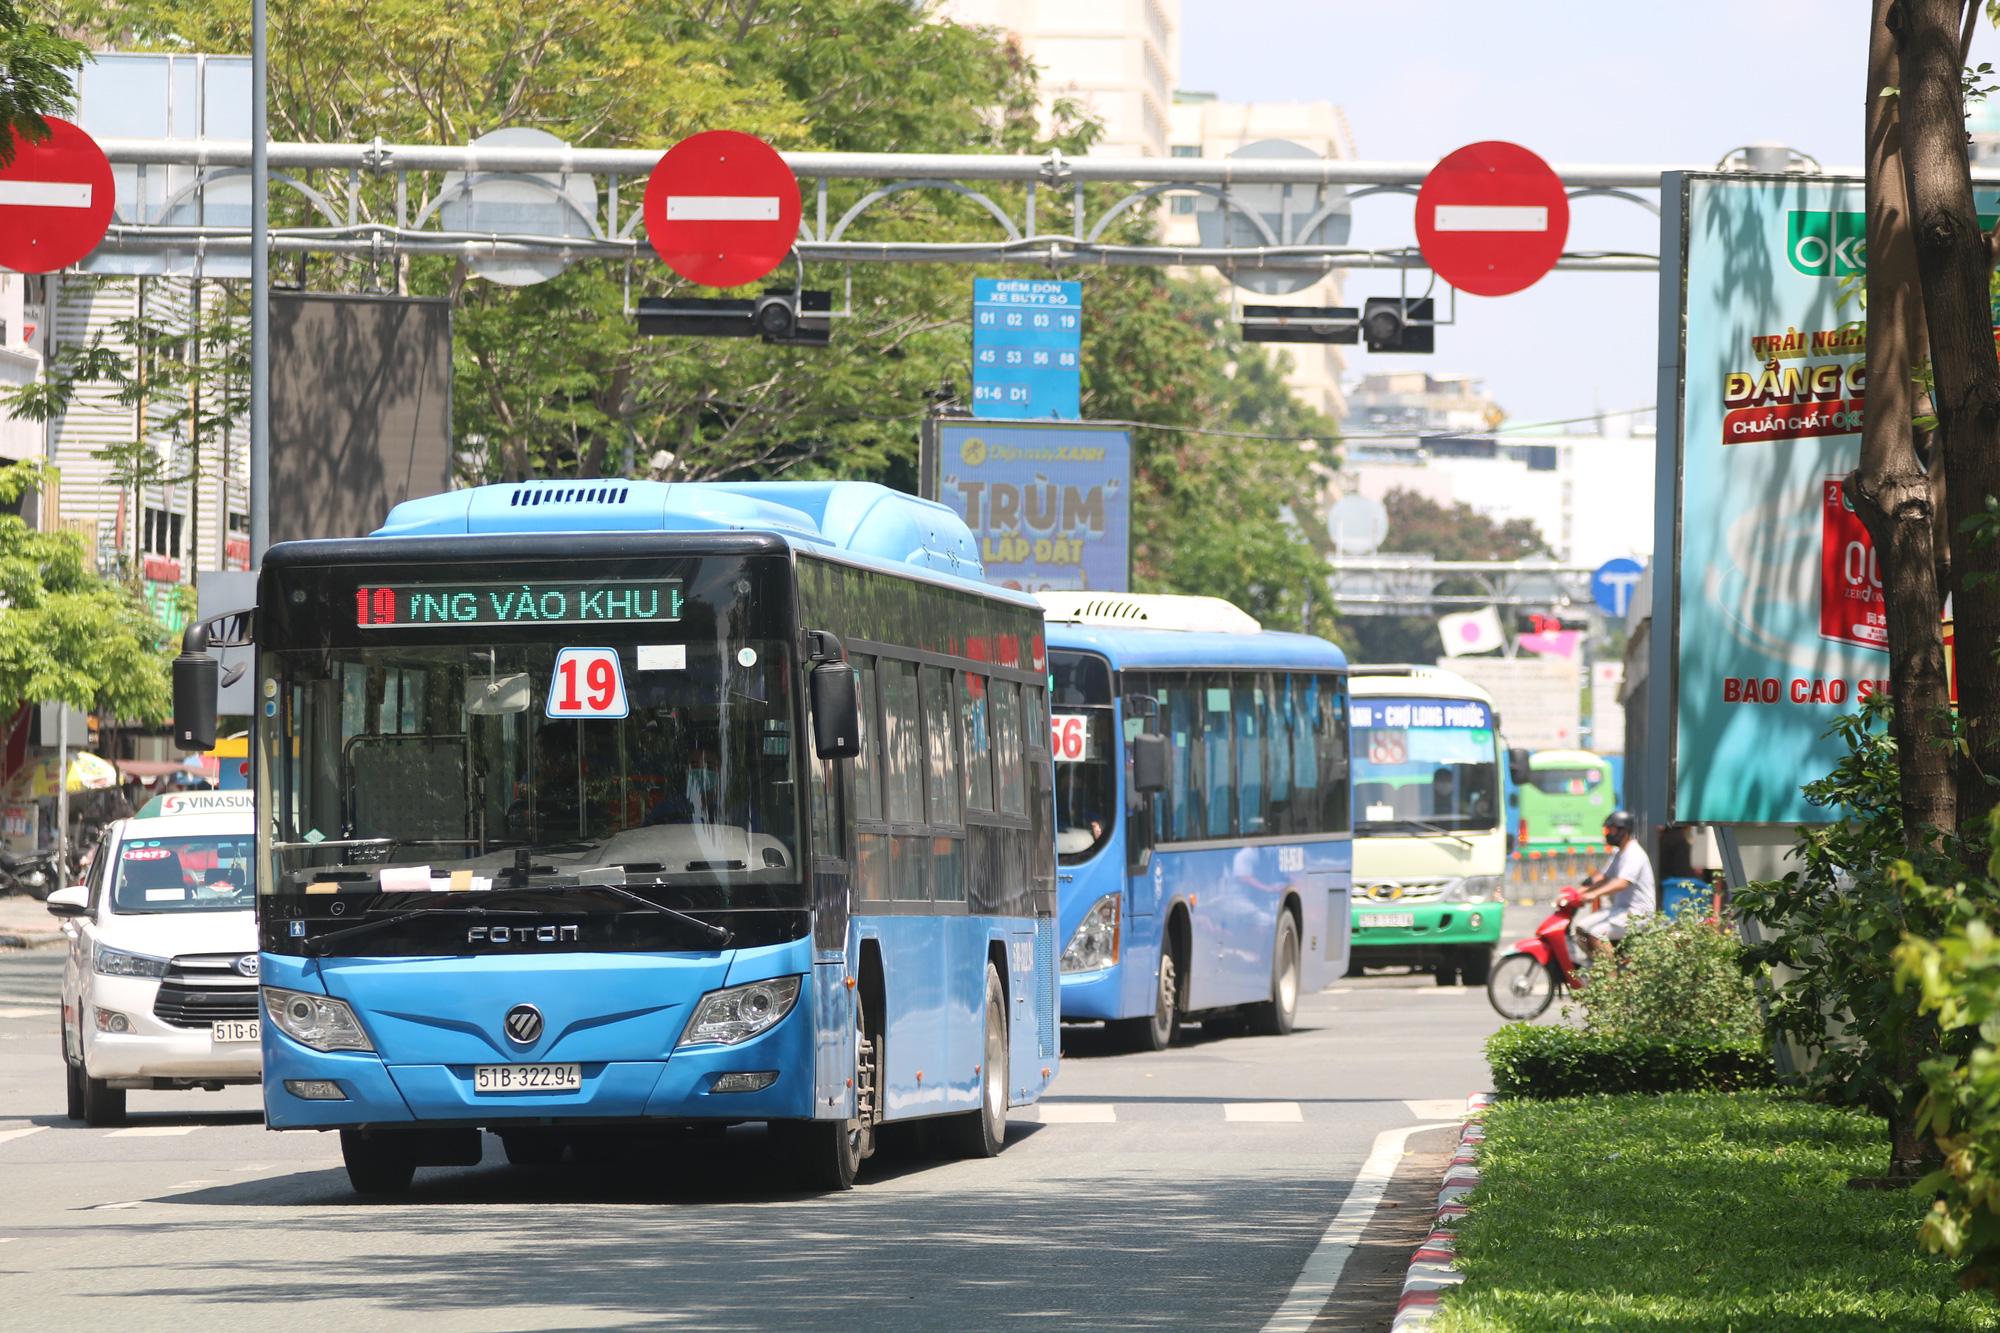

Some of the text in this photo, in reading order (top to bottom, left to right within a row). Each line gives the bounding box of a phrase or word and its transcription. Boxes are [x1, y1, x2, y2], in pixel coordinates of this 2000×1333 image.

[990, 292, 1008, 302] XE
[980, 312, 1075, 328] 01 02 03 19
[1752, 327, 1808, 361] TRẢI
[979, 350, 1075, 365] 45 53 56 88
[975, 386, 1027, 400] 61-6 D1
[1724, 357, 1842, 409] ĐẲNG
[1788, 411, 1830, 430] CHẤT
[356, 588, 395, 624] 19
[490, 585, 567, 620] VÀO
[580, 590, 658, 618] KHU
[560, 658, 616, 711] 19
[1724, 678, 1783, 704] BAO
[1789, 678, 1849, 704] CAO
[1412, 706, 1443, 727] LONG
[1051, 718, 1082, 759] 56
[1374, 729, 1404, 763] 88
[189, 796, 254, 808] VINASUN
[468, 925, 580, 943] FOTON
[479, 1066, 576, 1087] 51B-322.94
